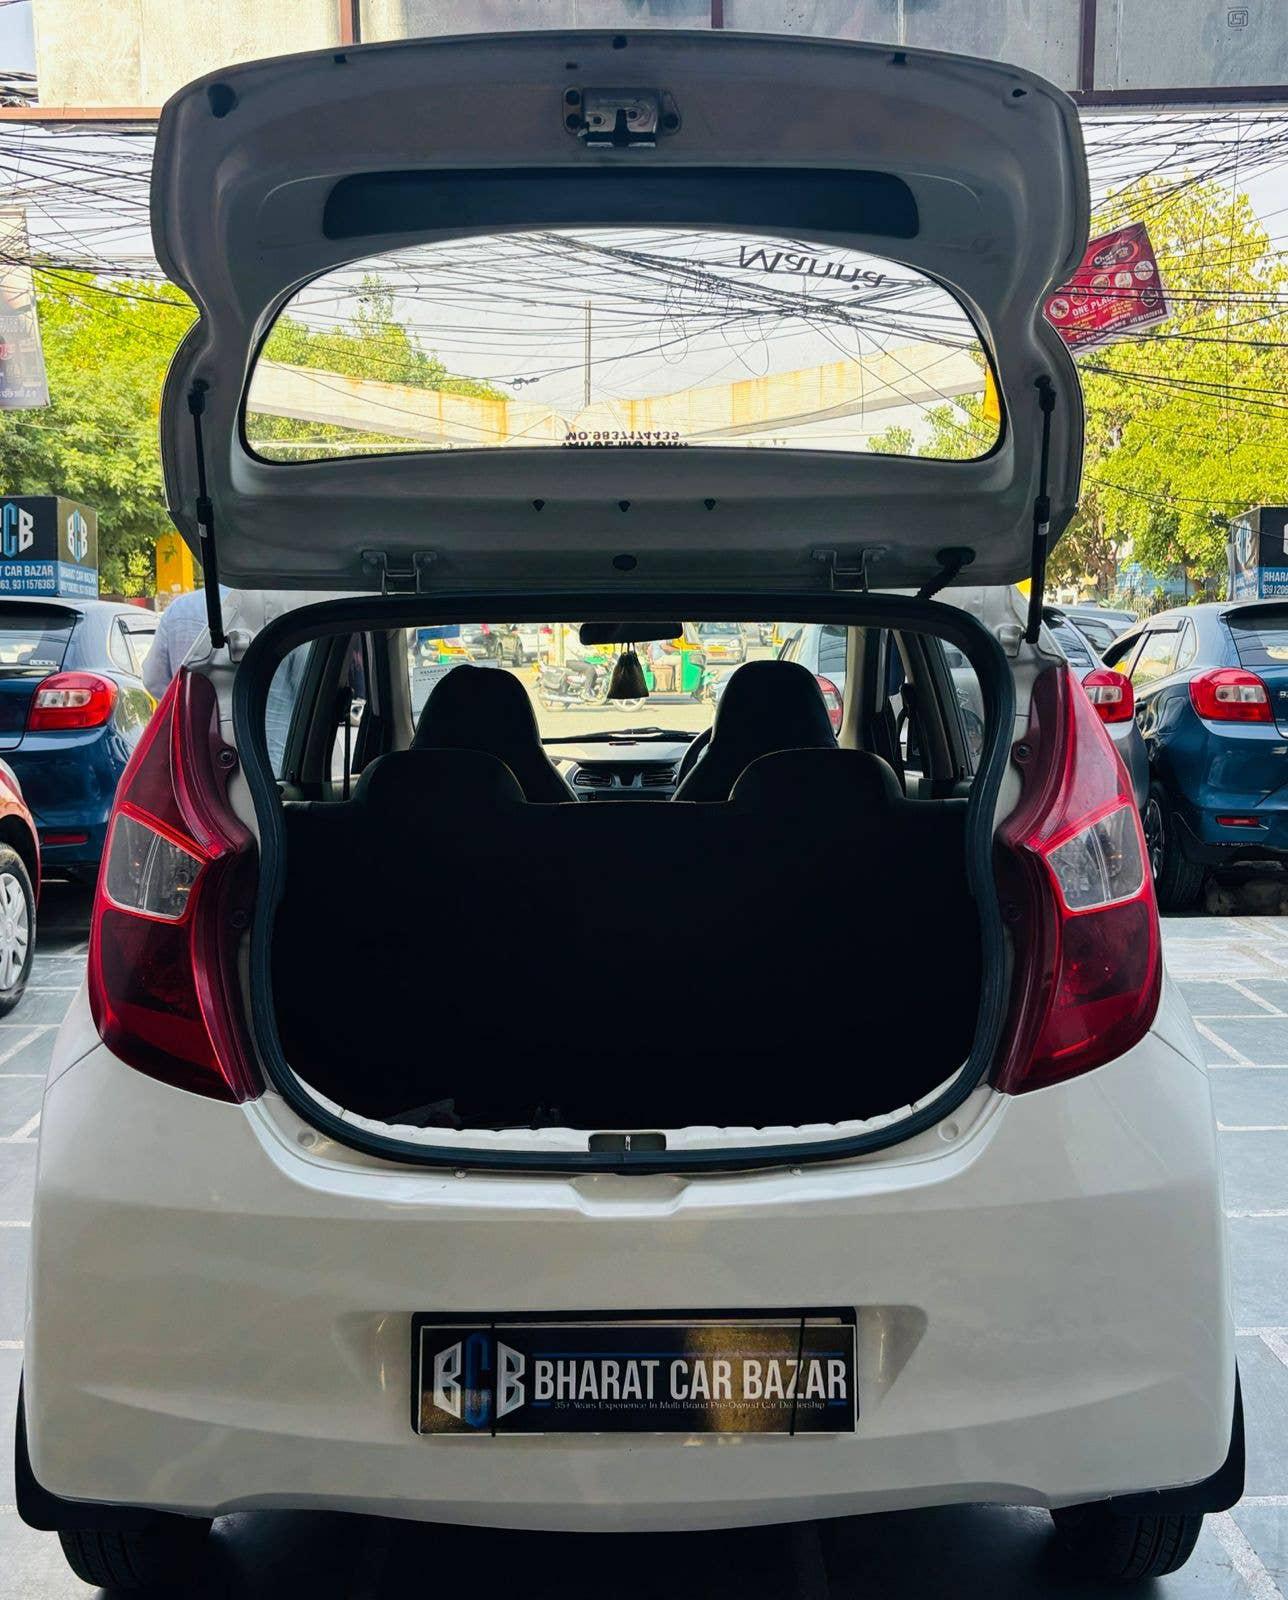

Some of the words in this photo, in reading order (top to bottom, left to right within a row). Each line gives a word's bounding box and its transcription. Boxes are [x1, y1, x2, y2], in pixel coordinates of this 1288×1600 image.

[1072, 304, 1089, 316] ONE
[0, 502, 34, 558] CB
[4, 565, 23, 577] CAR
[24, 565, 54, 577] BAZAR
[1263, 571, 1288, 582] BHAR
[433, 1333, 526, 1429] BCB
[535, 1360, 660, 1400] BHARAT
[670, 1360, 732, 1400] CAR
[743, 1359, 847, 1399] BAZAR
[599, 1401, 647, 1411] Experience
[682, 1401, 708, 1409] Brand
